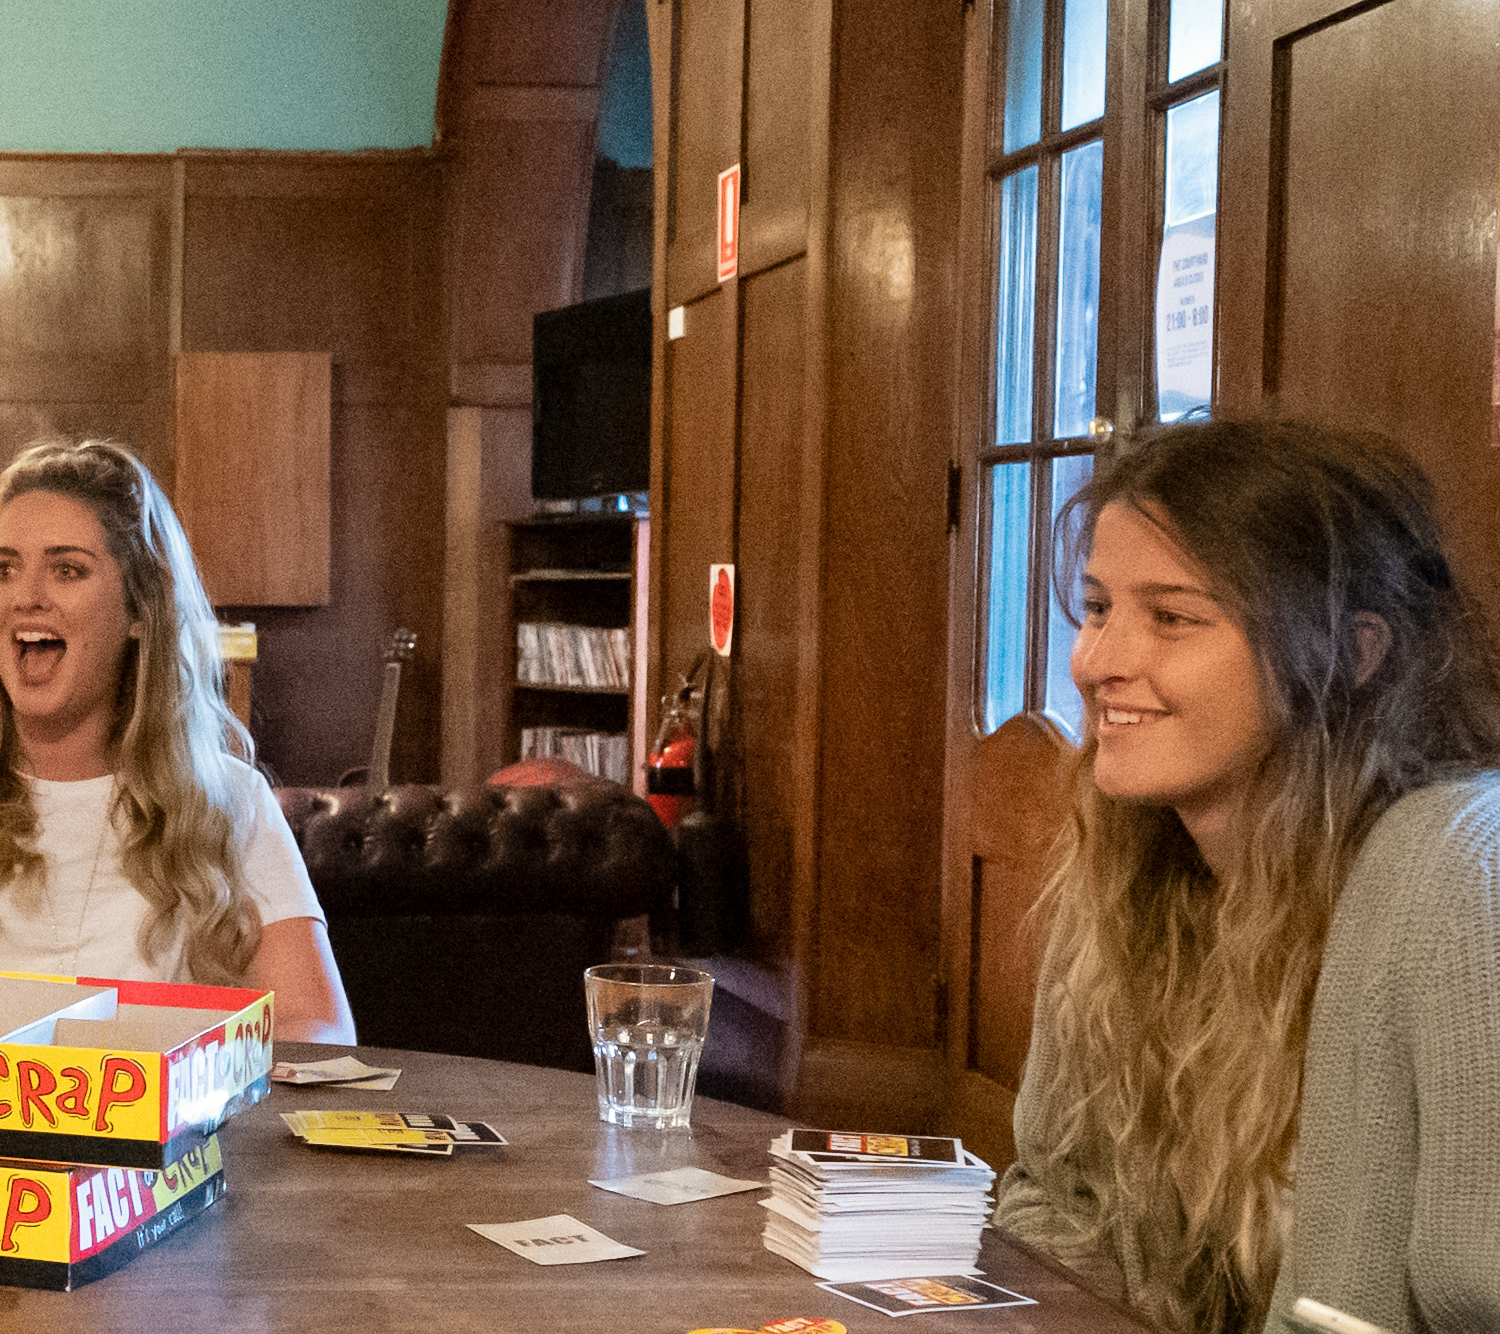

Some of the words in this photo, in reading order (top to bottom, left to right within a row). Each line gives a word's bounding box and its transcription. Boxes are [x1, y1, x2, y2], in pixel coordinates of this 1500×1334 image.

[166, 1038, 221, 1133] FACT
[76, 1168, 144, 1251] FACT
[513, 1233, 590, 1250] FACT
